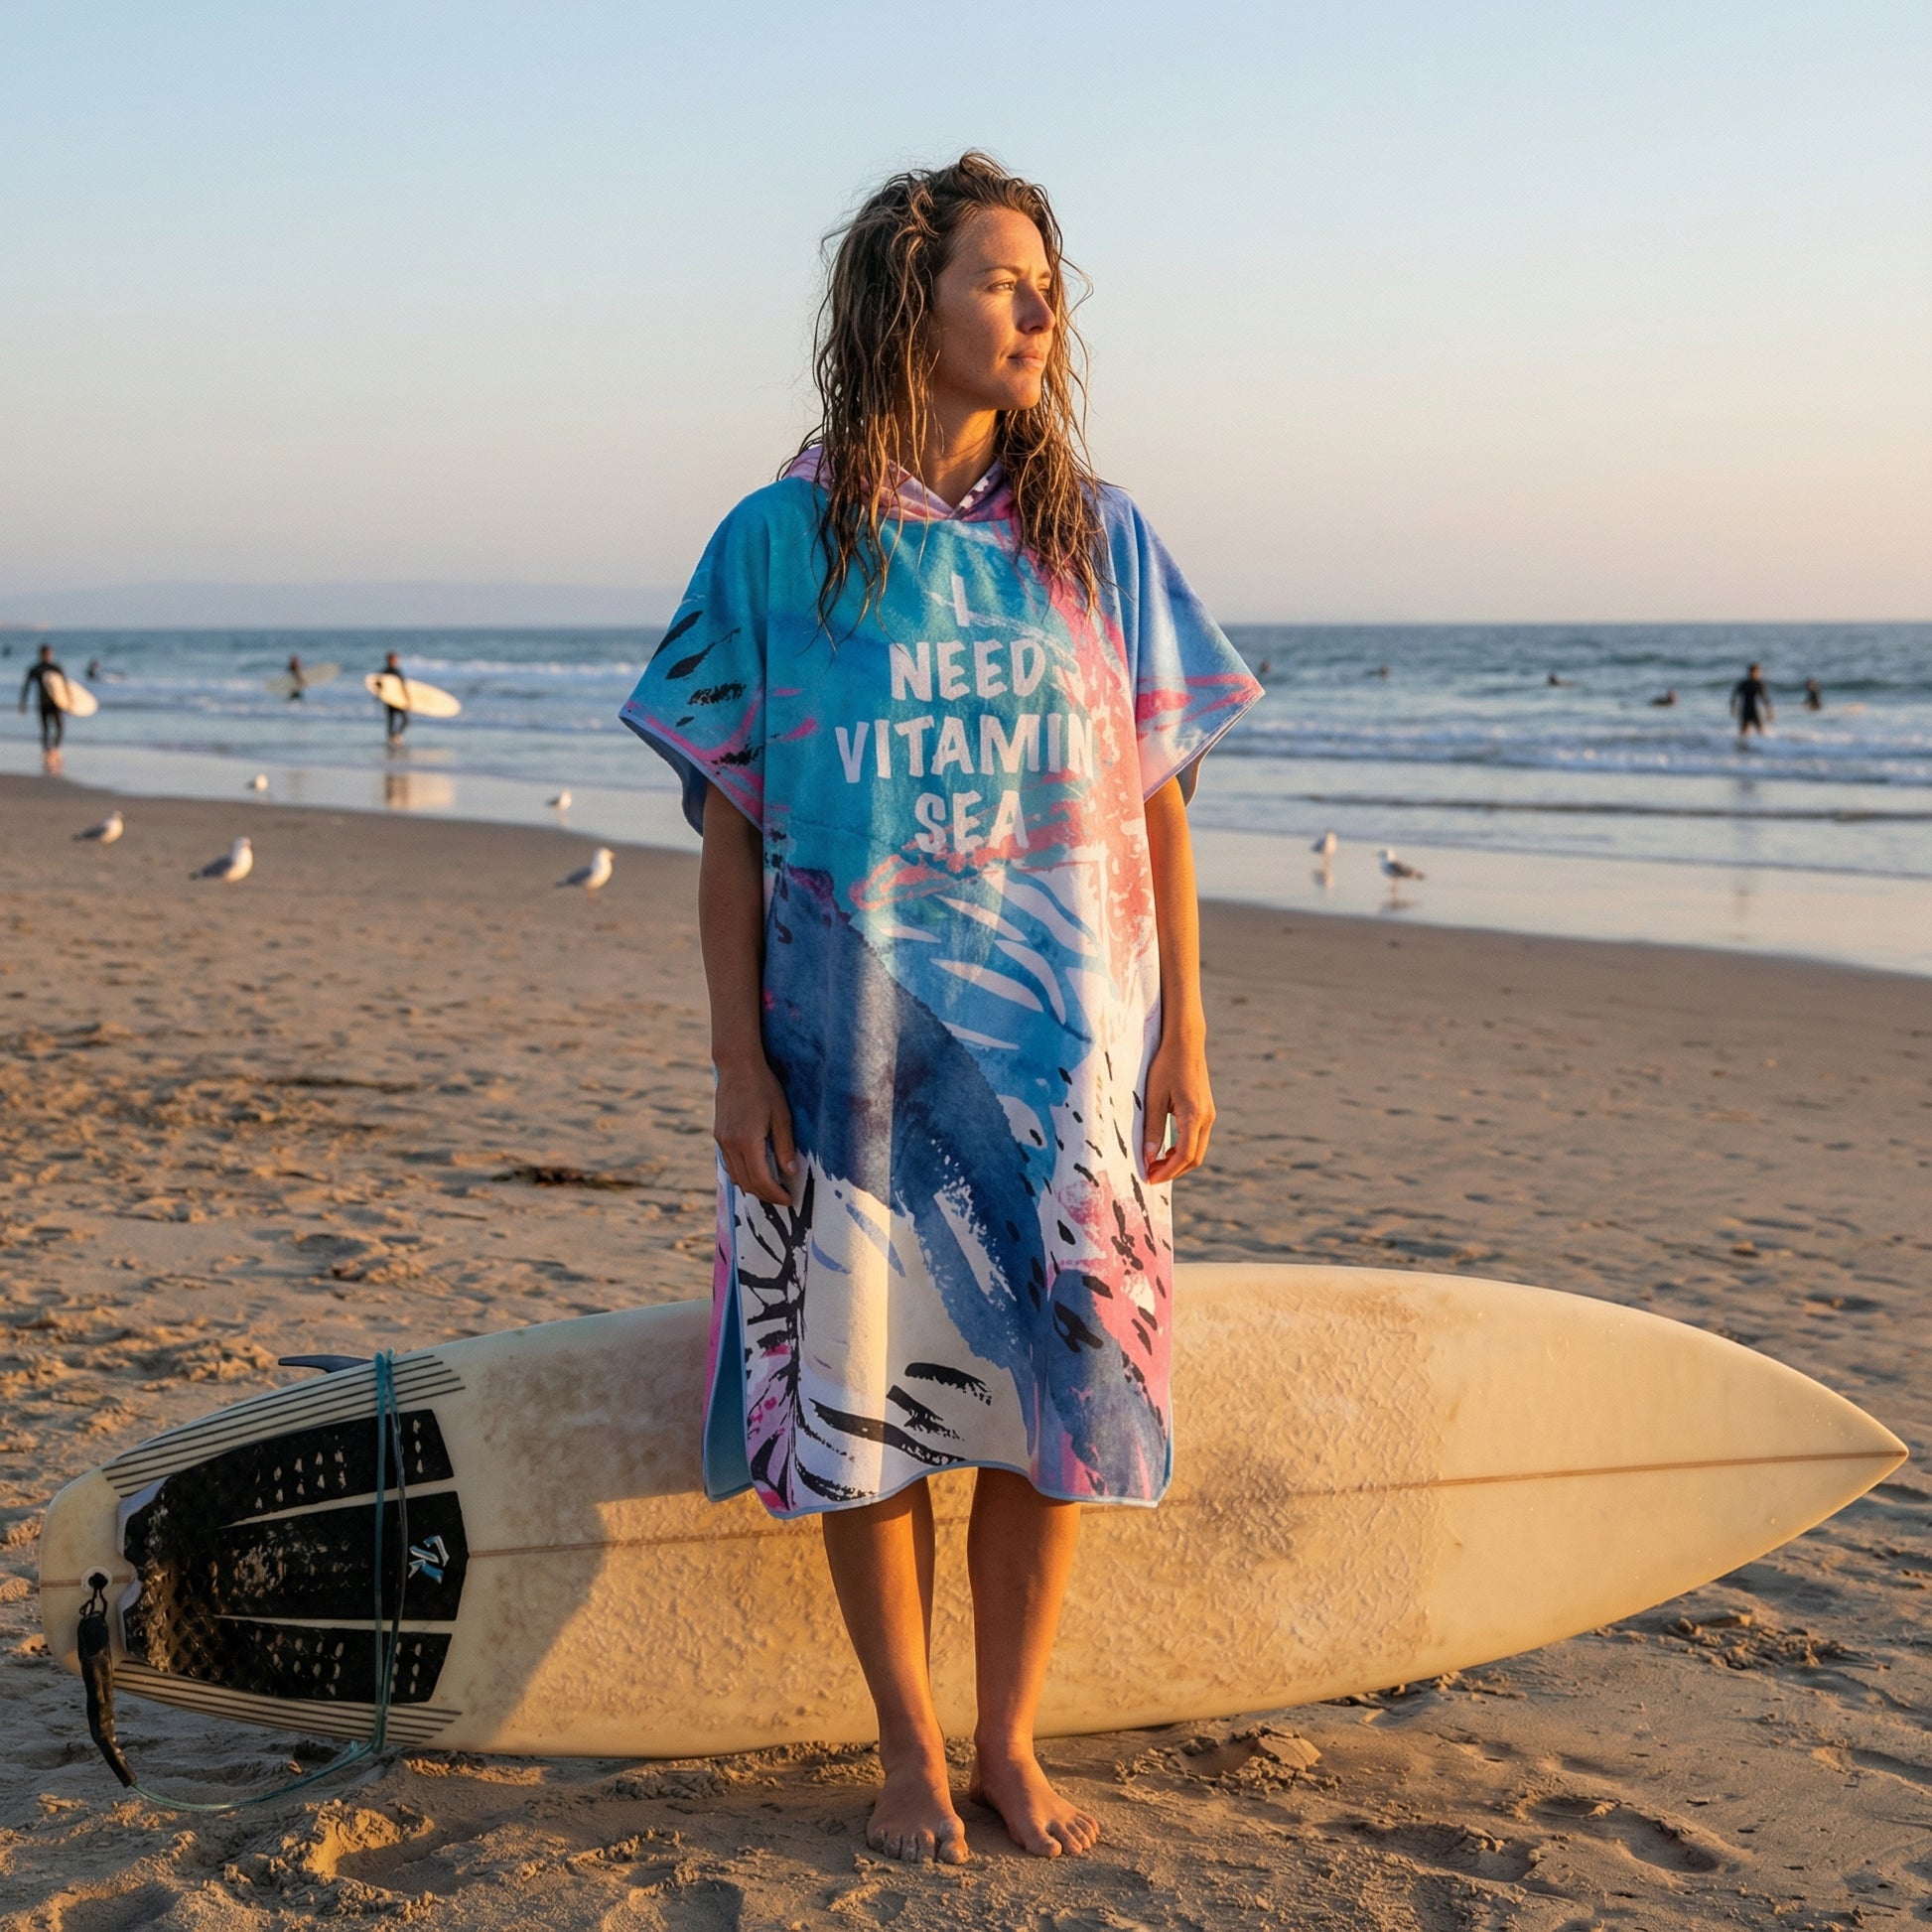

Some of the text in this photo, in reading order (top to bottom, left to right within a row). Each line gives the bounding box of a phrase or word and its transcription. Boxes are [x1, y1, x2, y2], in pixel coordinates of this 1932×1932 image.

[951, 571, 970, 627] I
[889, 639, 1046, 701] NEED
[835, 713, 1094, 783] VITAMIN
[914, 790, 1029, 852] SEA
